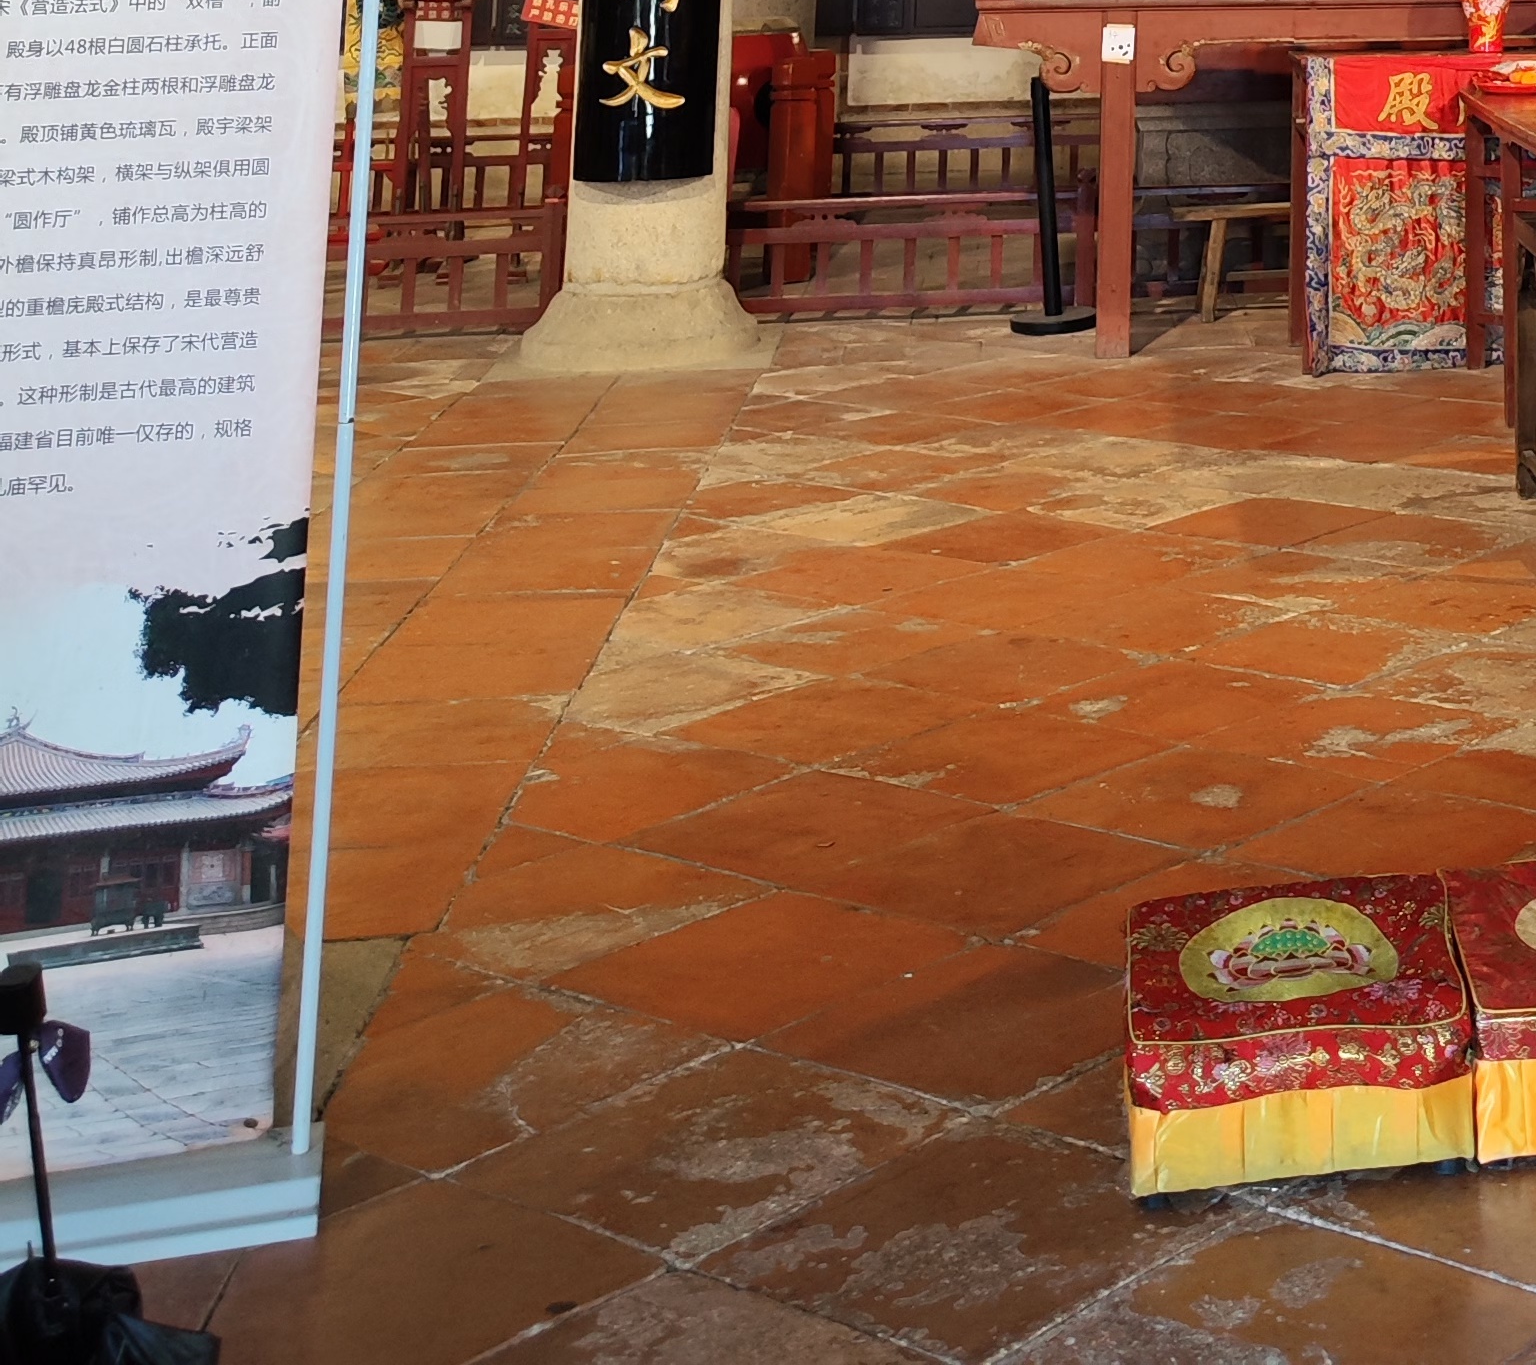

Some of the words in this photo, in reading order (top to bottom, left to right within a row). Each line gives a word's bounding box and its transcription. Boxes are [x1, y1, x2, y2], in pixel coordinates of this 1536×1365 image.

[0, 73, 276, 102] 有浮雕盘龙金柱两根和浮雕盘龙
[1378, 72, 1466, 130] 殿
[0, 288, 261, 317] 的重檐庑殿式结构，是最尊贵
[0, 330, 259, 362] 形式，基本上保存了宋代营造
